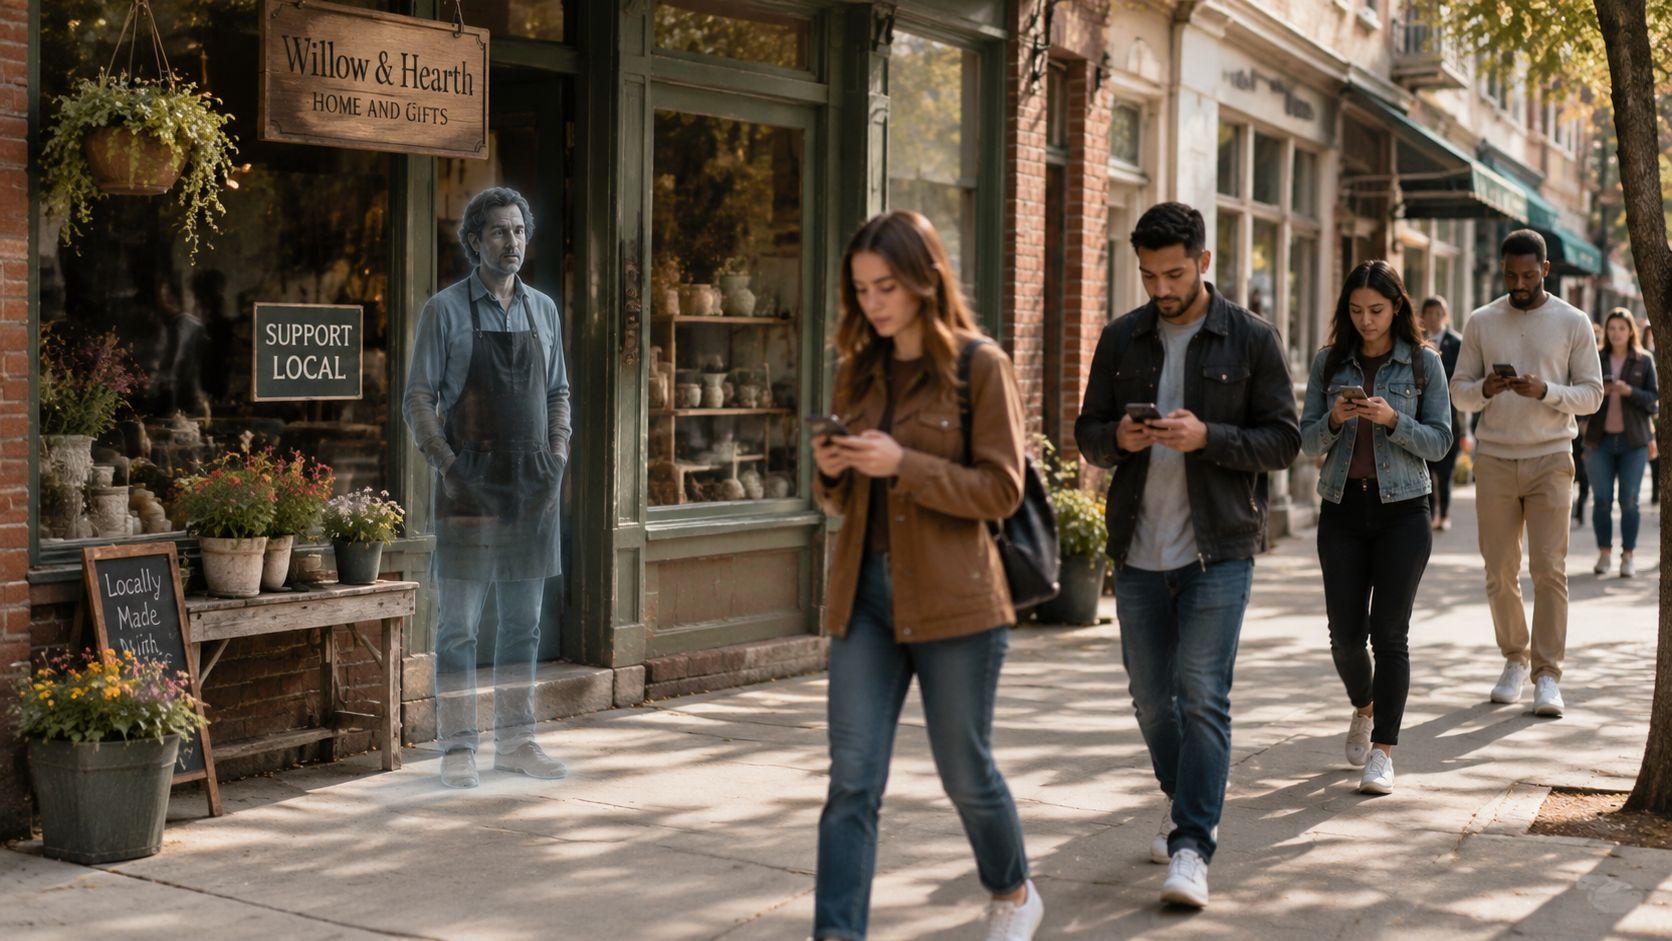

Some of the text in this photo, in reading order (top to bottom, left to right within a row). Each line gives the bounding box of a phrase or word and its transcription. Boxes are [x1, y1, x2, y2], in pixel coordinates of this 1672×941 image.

[282, 35, 473, 96] Willow & Hearth
[312, 92, 448, 126] HOME AND GIFTS
[265, 323, 353, 346] SUPPORT
[273, 355, 347, 380] LOCAL
[104, 567, 161, 601] Locally
[117, 601, 161, 630] Made
